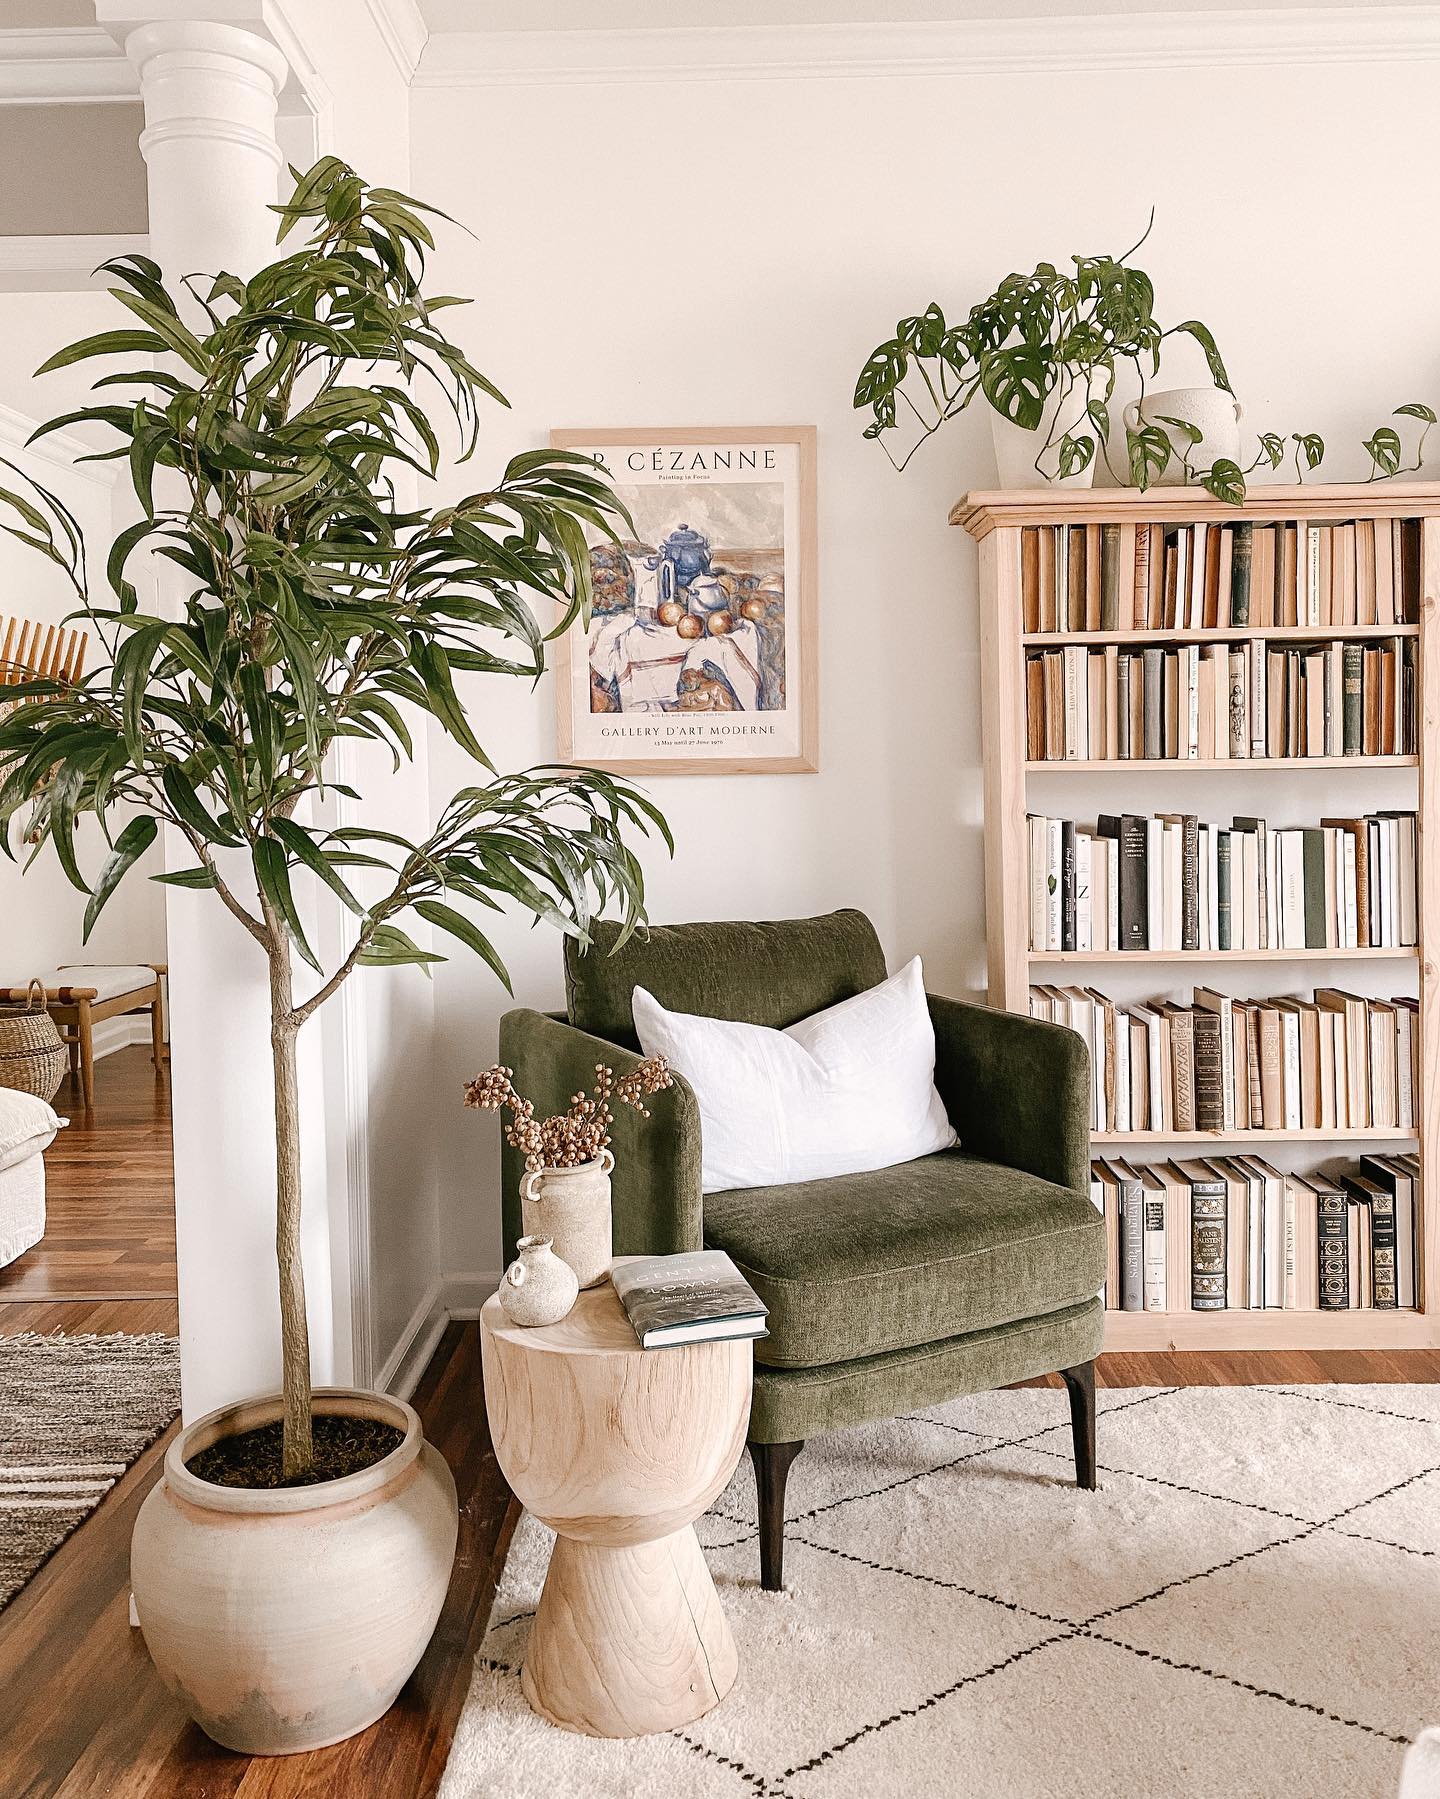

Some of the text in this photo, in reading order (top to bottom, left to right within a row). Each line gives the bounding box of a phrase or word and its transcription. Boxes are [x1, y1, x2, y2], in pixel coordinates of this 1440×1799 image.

[627, 448, 776, 471] CÉZANNE
[601, 725, 776, 737] GALLERY D'ART MODERNE
[1183, 820, 1195, 890] Cilka's Journey
[1127, 1186, 1142, 1278] Salvaged Pages
[650, 1278, 720, 1294] LOWLY
